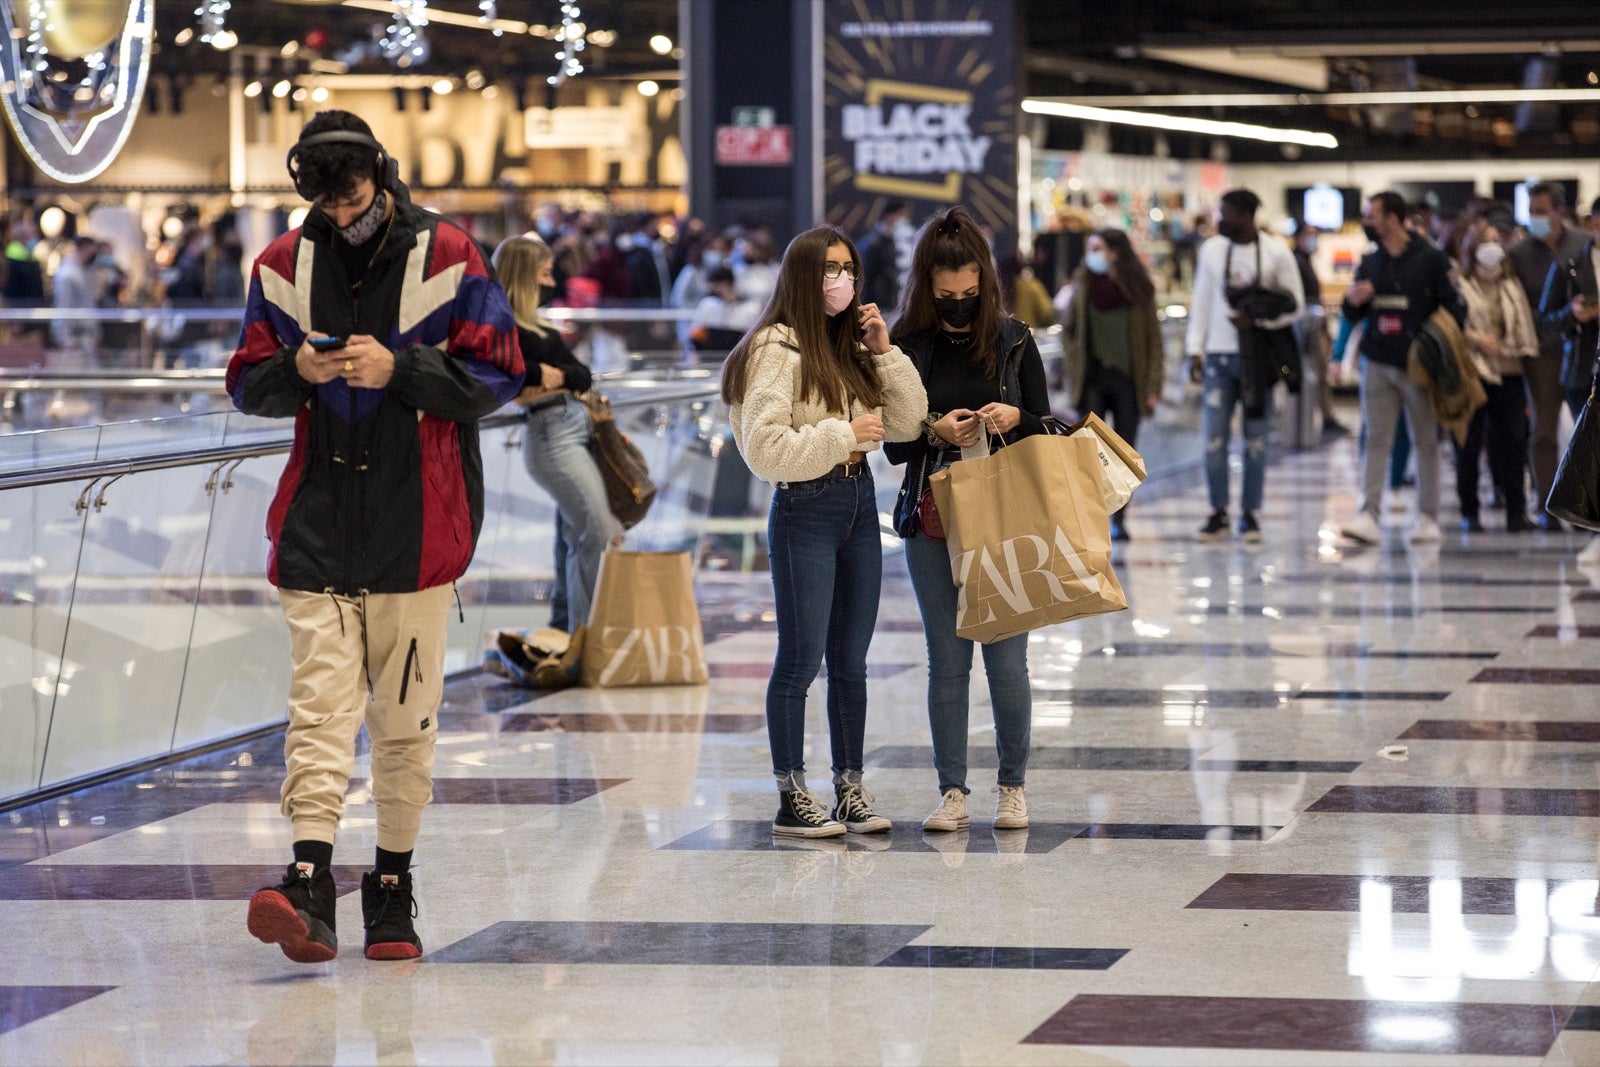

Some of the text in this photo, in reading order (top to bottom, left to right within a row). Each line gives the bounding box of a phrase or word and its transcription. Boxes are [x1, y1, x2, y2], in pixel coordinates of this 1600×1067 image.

[841, 103, 973, 140] BLACK
[854, 134, 993, 174] FRIDAY
[950, 523, 1101, 630] ZARA
